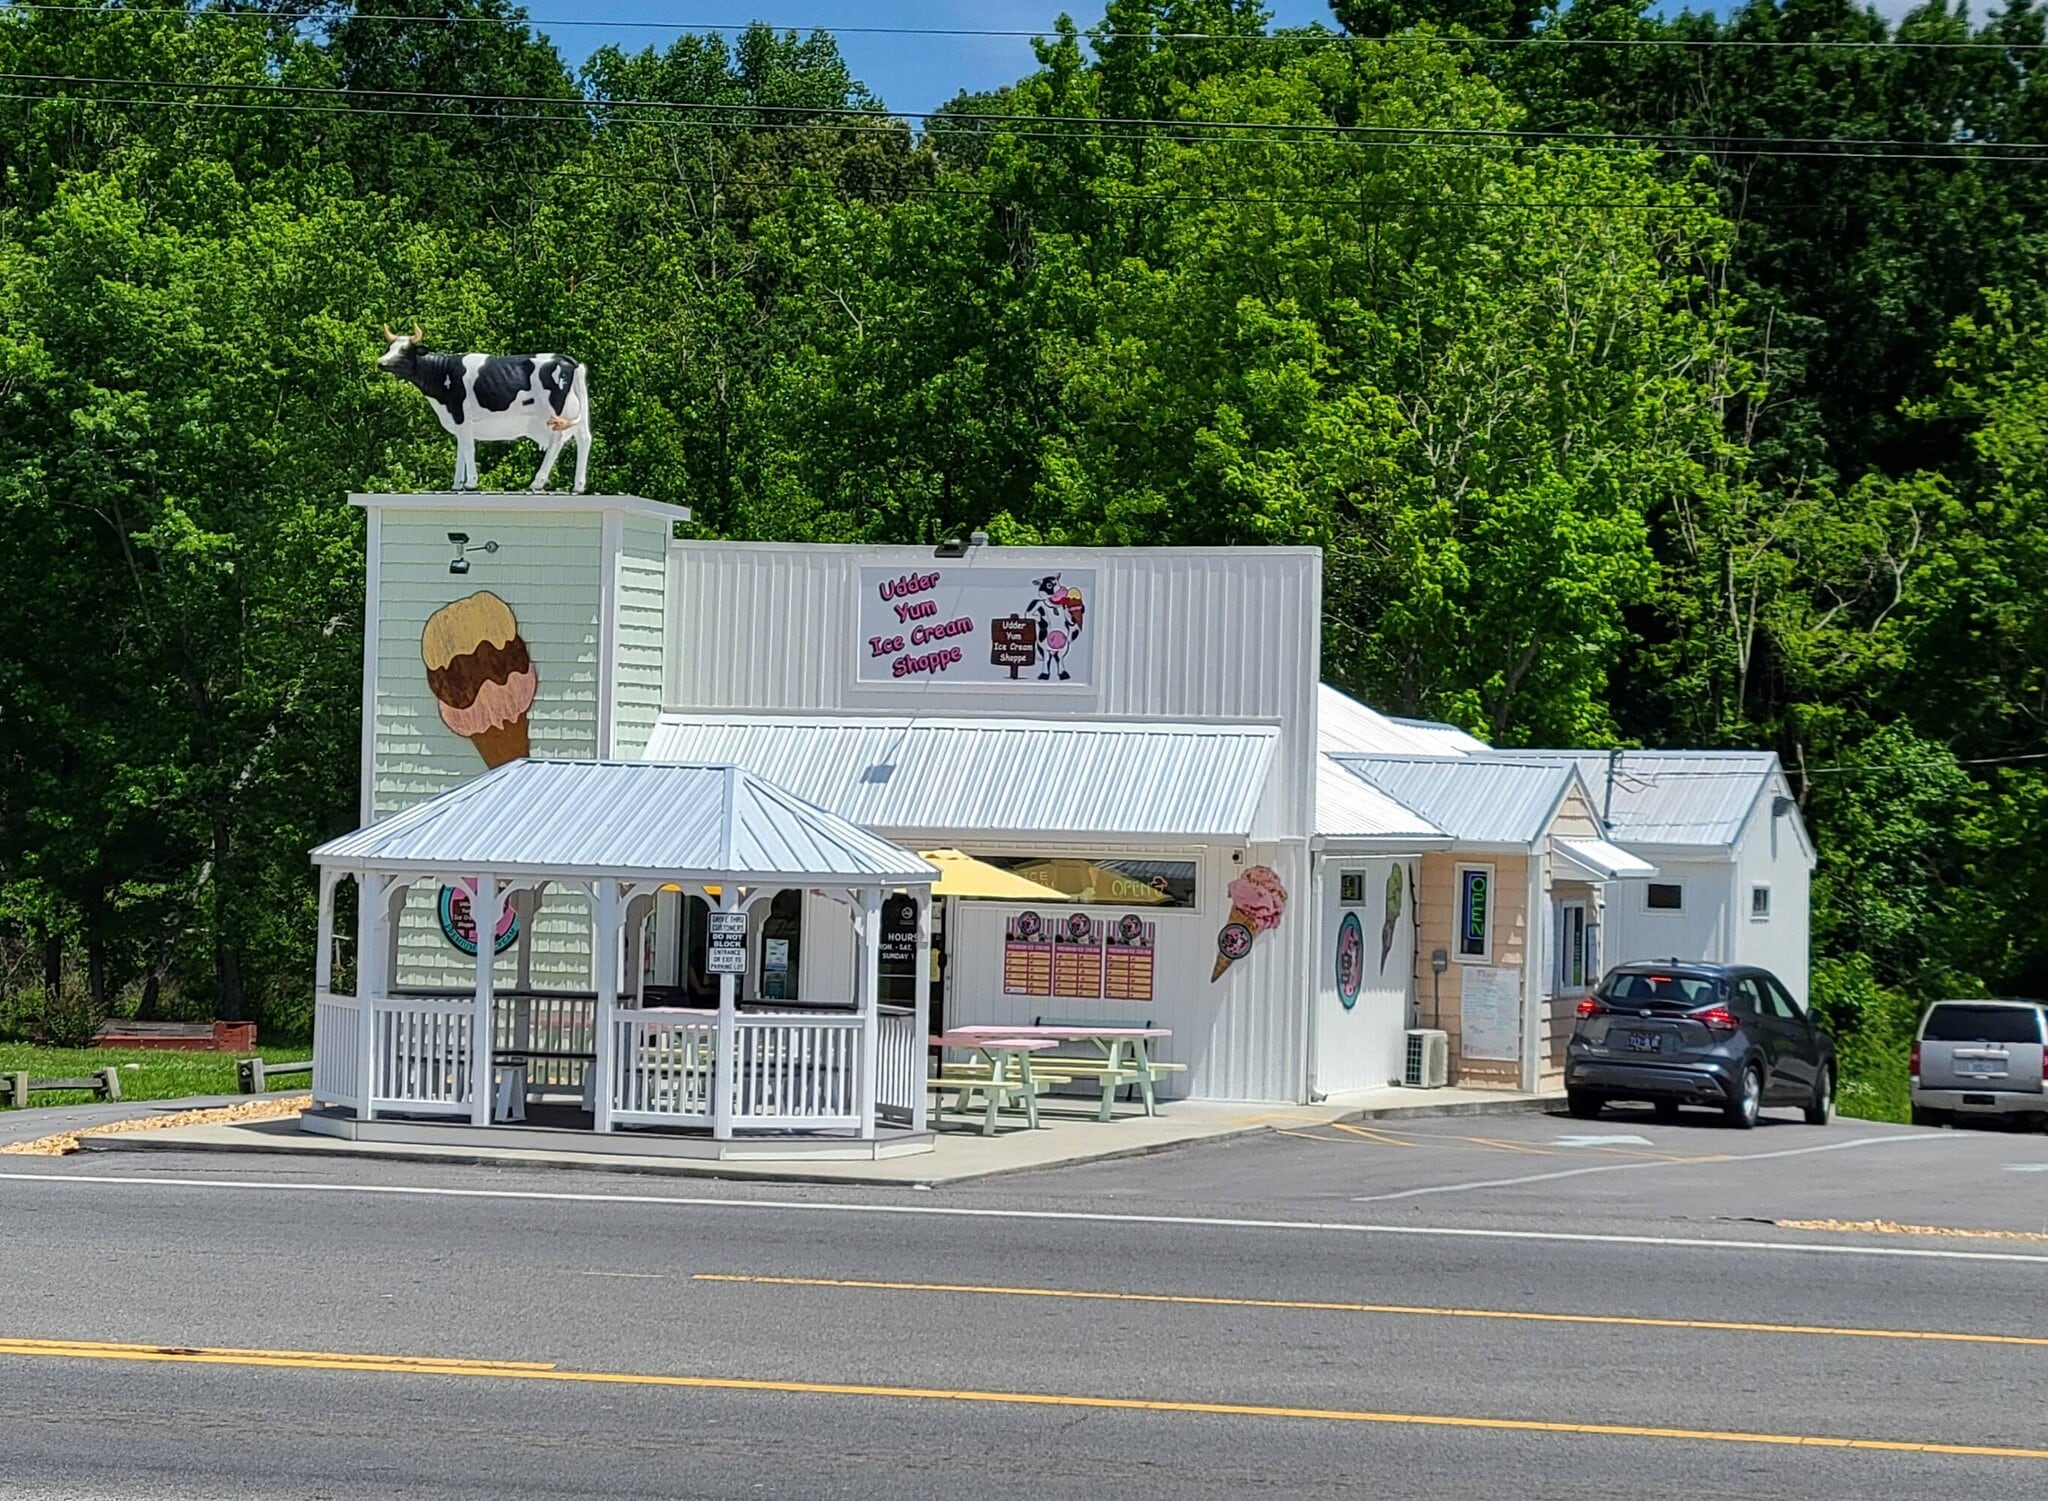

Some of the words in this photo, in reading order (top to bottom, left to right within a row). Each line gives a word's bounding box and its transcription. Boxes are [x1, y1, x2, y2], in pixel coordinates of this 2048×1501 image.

[879, 572, 940, 601] Udder
[894, 600, 937, 624] Yum
[1002, 620, 1026, 630] Udder
[869, 636, 905, 657] Ice
[911, 617, 973, 645] Cream
[1006, 631, 1022, 640] Yum
[994, 642, 1007, 651] Ice
[1009, 642, 1033, 651] Cream
[893, 646, 962, 677] Shoppe
[1000, 652, 1027, 663] Shoppe
[1111, 880, 1151, 898] OPEN
[1471, 877, 1486, 936] OPEN
[726, 933, 743, 941] NOT
